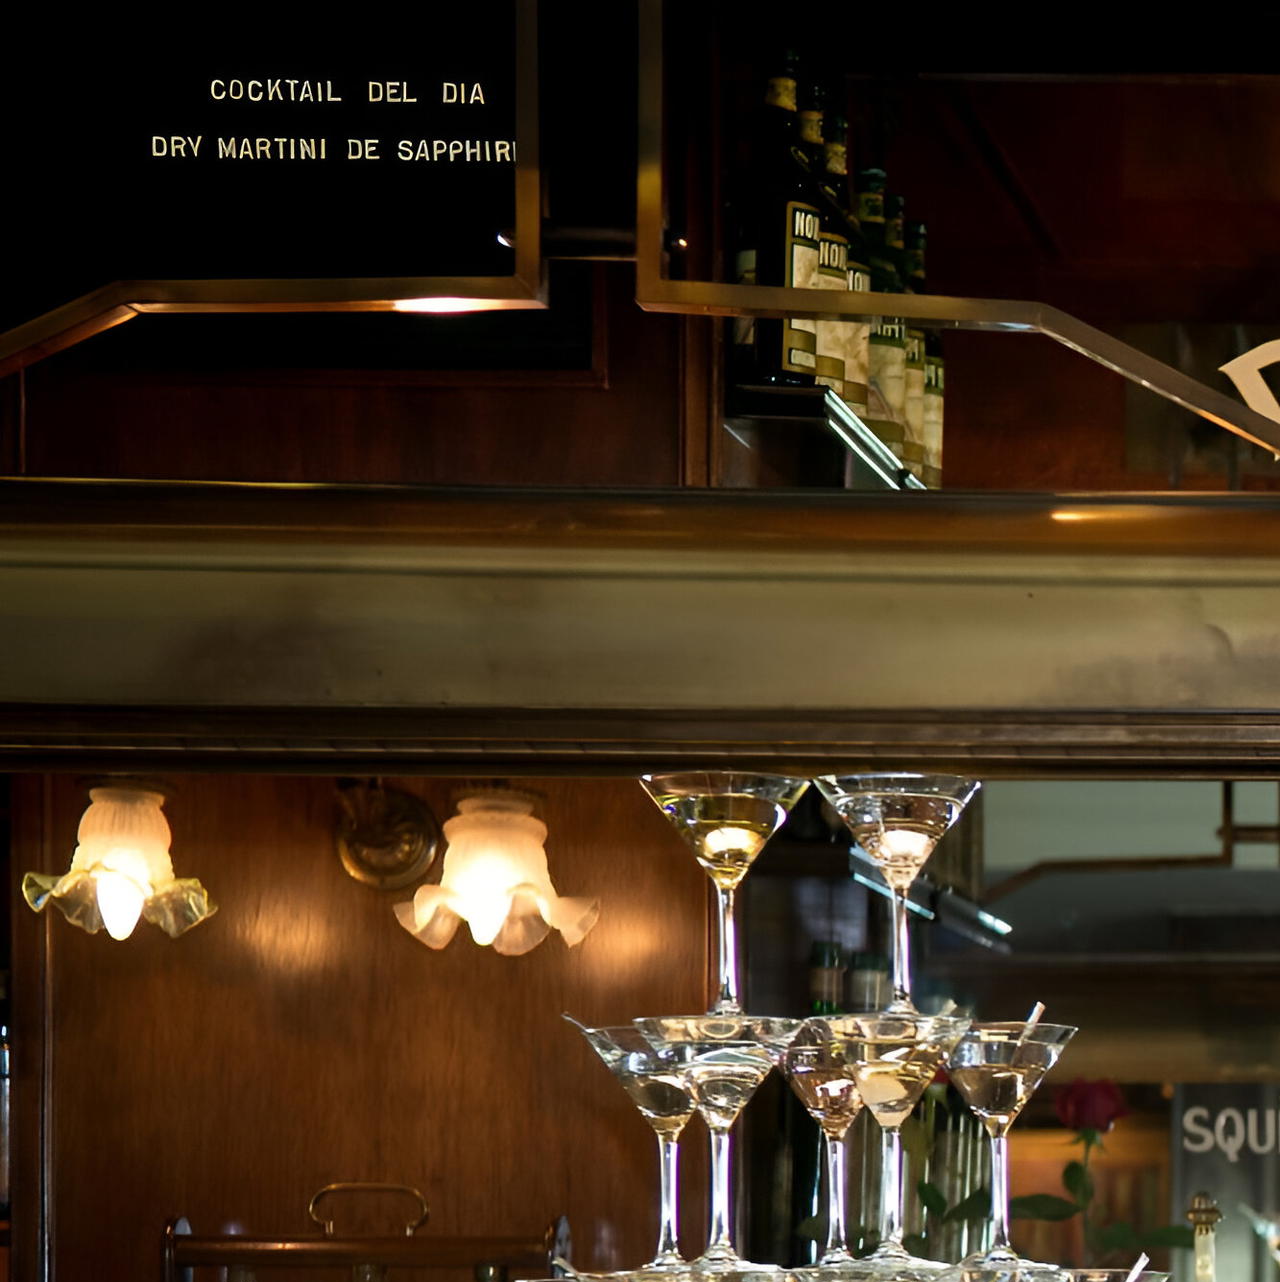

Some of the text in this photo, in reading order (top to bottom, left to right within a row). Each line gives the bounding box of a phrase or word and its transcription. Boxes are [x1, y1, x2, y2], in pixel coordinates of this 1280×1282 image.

[210, 79, 485, 105] COCKTAIL DEL DIA
[151, 135, 516, 162] DRY MARTINI DE SAPPHIR
